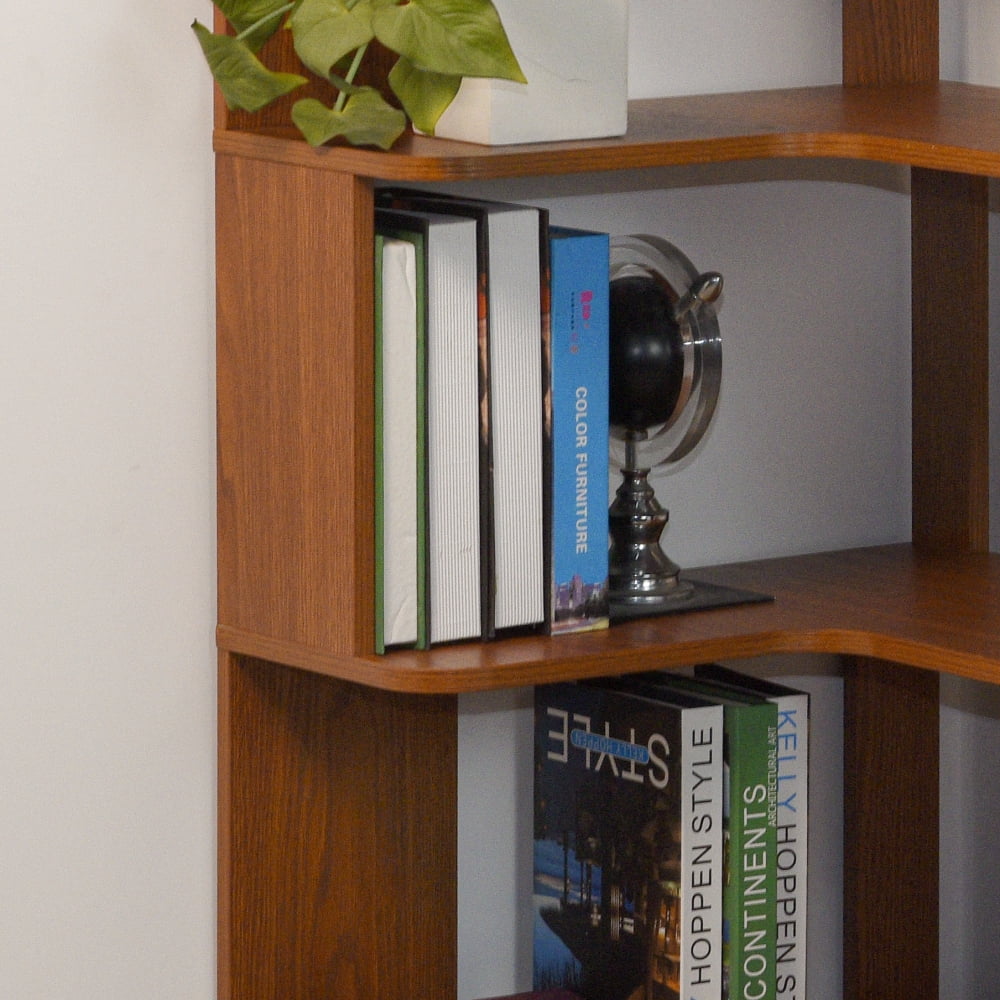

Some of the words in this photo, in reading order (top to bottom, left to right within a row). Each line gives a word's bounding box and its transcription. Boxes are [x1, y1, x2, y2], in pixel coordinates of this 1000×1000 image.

[575, 386, 588, 448] COLOR
[575, 453, 588, 554] FURNITURE
[692, 727, 713, 833] STYLE
[767, 726, 777, 745] ART
[691, 844, 712, 986] HOPPEN
[743, 784, 767, 1000] CONTINENTS
[776, 824, 797, 964] HOPPEN
